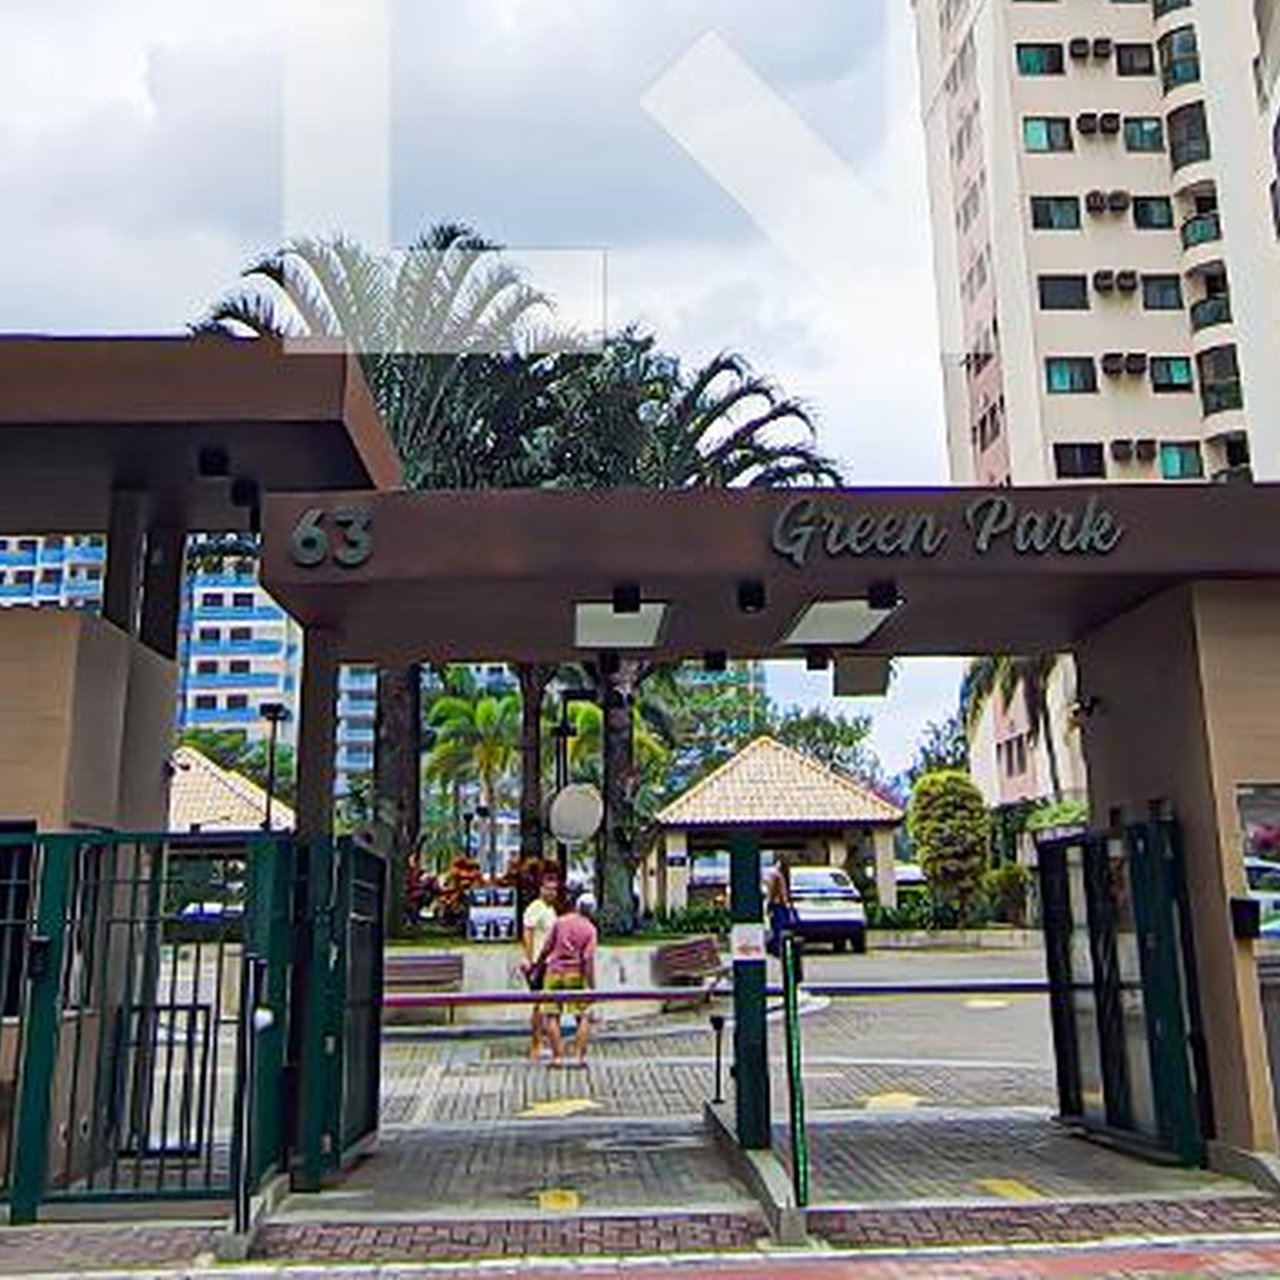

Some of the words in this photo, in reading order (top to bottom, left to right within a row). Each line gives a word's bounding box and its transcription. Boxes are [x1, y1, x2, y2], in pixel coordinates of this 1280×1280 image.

[290, 507, 374, 567] 63
[771, 497, 949, 568] Green
[966, 495, 1124, 557] Park
